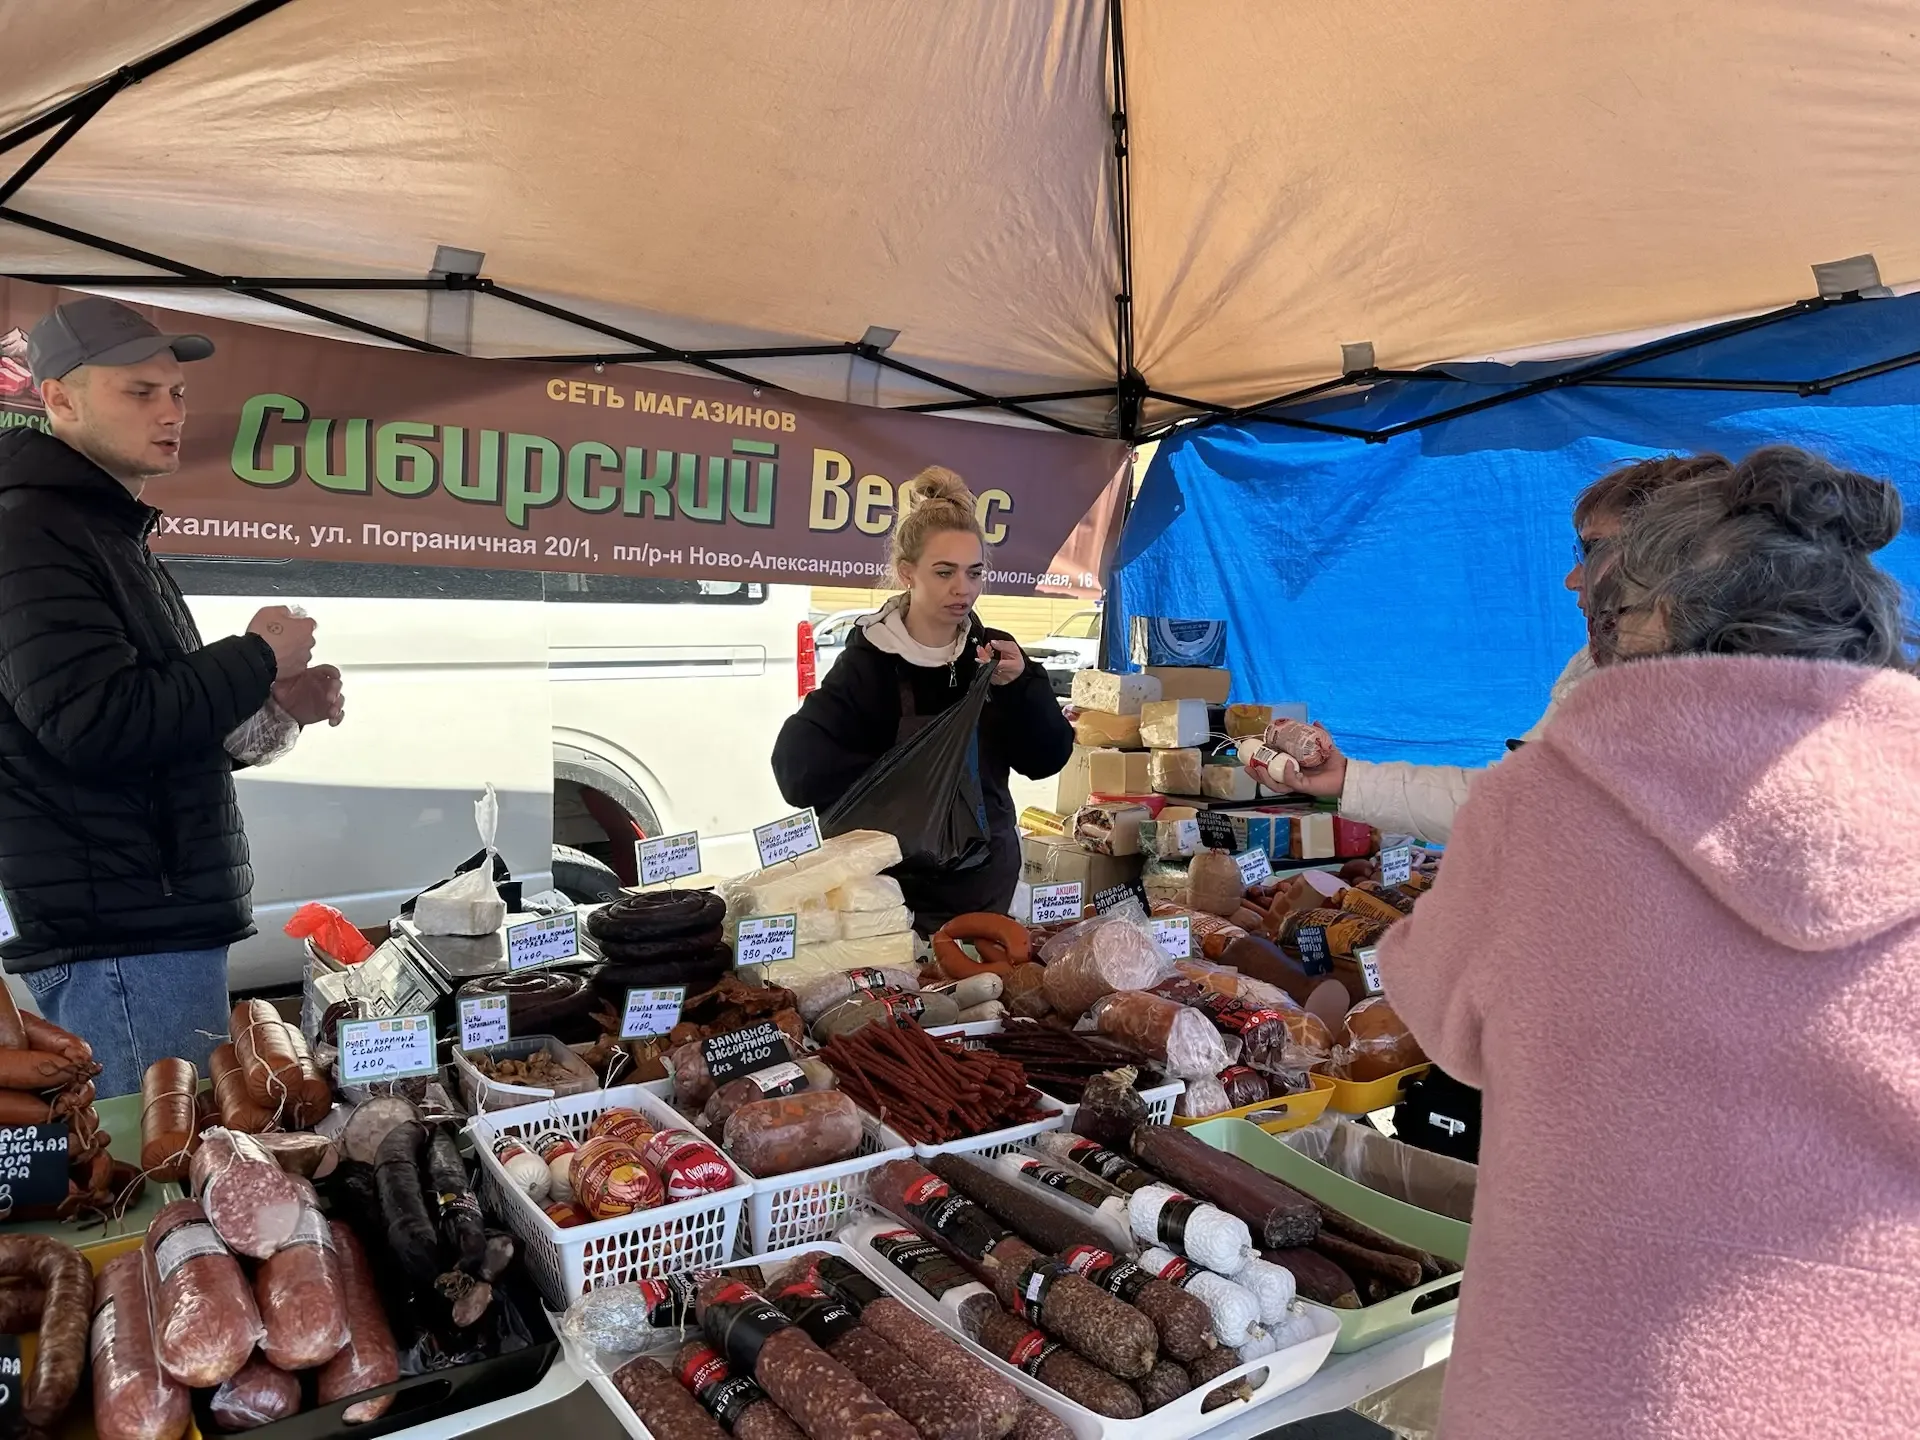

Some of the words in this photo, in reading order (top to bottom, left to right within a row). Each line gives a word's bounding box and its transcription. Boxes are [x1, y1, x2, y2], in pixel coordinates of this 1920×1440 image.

[546, 378, 625, 409] СЕТЬ
[634, 390, 797, 433] МАГАЗИНОВ
[231, 393, 779, 529] Сибирский
[808, 447, 1013, 546] Вес
[309, 522, 352, 548] ул.
[362, 523, 537, 555] Пограничная
[544, 535, 600, 562] 20/1,
[612, 543, 682, 567] пл/р-н
[1077, 572, 1094, 588] 16
[1055, 884, 1079, 896] АКЦИЯ!
[1095, 883, 1126, 899] КОЛБАСА
[1036, 910, 1056, 920] 790
[345, 1039, 370, 1049] РУЛЕТ
[708, 1022, 773, 1050] ЗАЛИВНОЕ
[360, 1044, 391, 1055] СЫРОМ
[740, 1046, 772, 1065] 1200
[353, 1057, 384, 1073] 1200
[0, 1126, 38, 1141] АСА
[0, 1136, 67, 1156] ЕНСКАЯ
